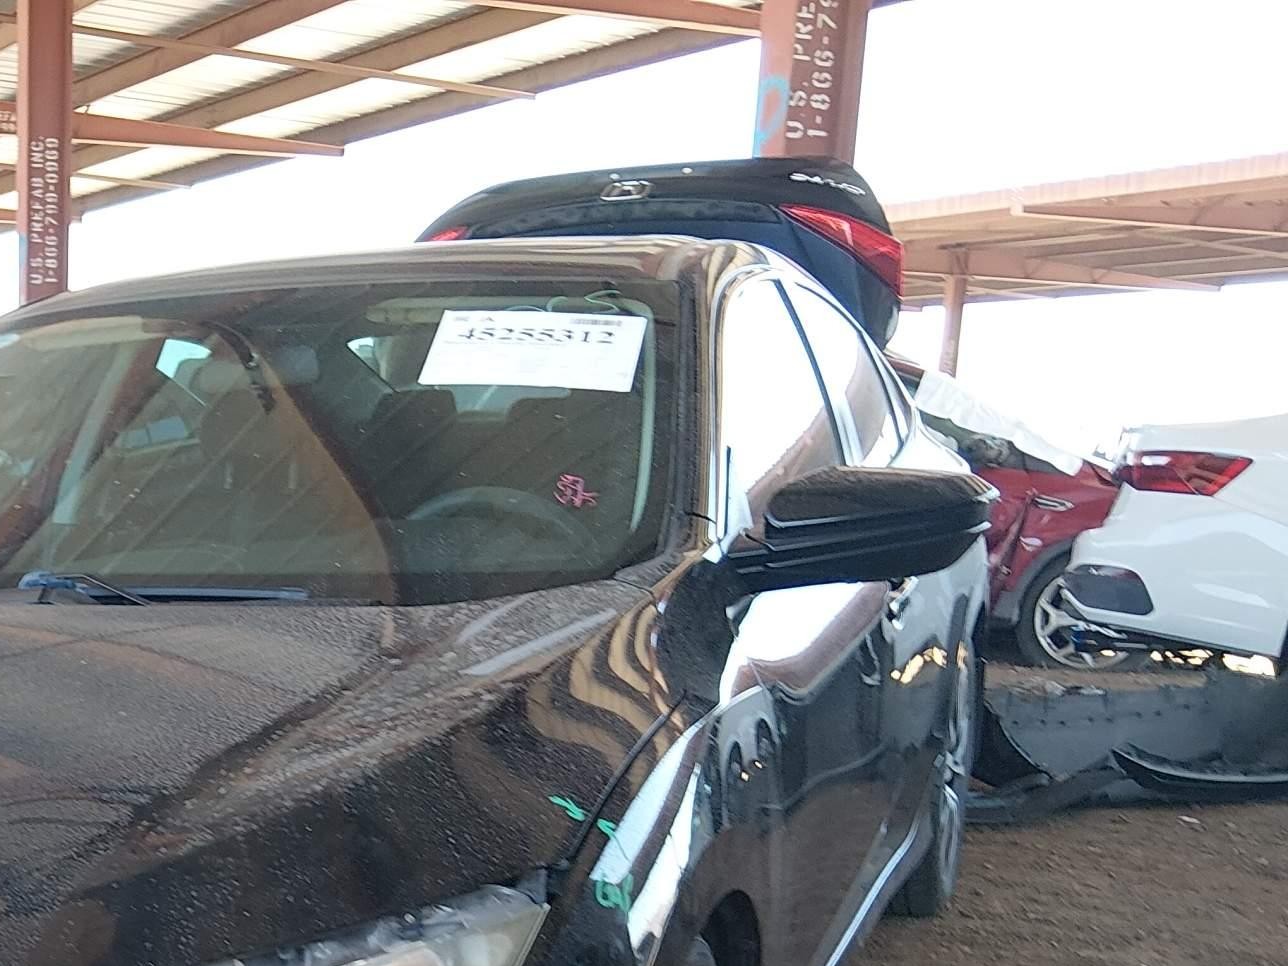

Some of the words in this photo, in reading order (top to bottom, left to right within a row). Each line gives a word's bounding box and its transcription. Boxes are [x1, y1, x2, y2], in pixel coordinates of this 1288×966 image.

[30, 135, 45, 168] INC.
[30, 177, 44, 243] PREFAB
[458, 327, 616, 344] 45255312
